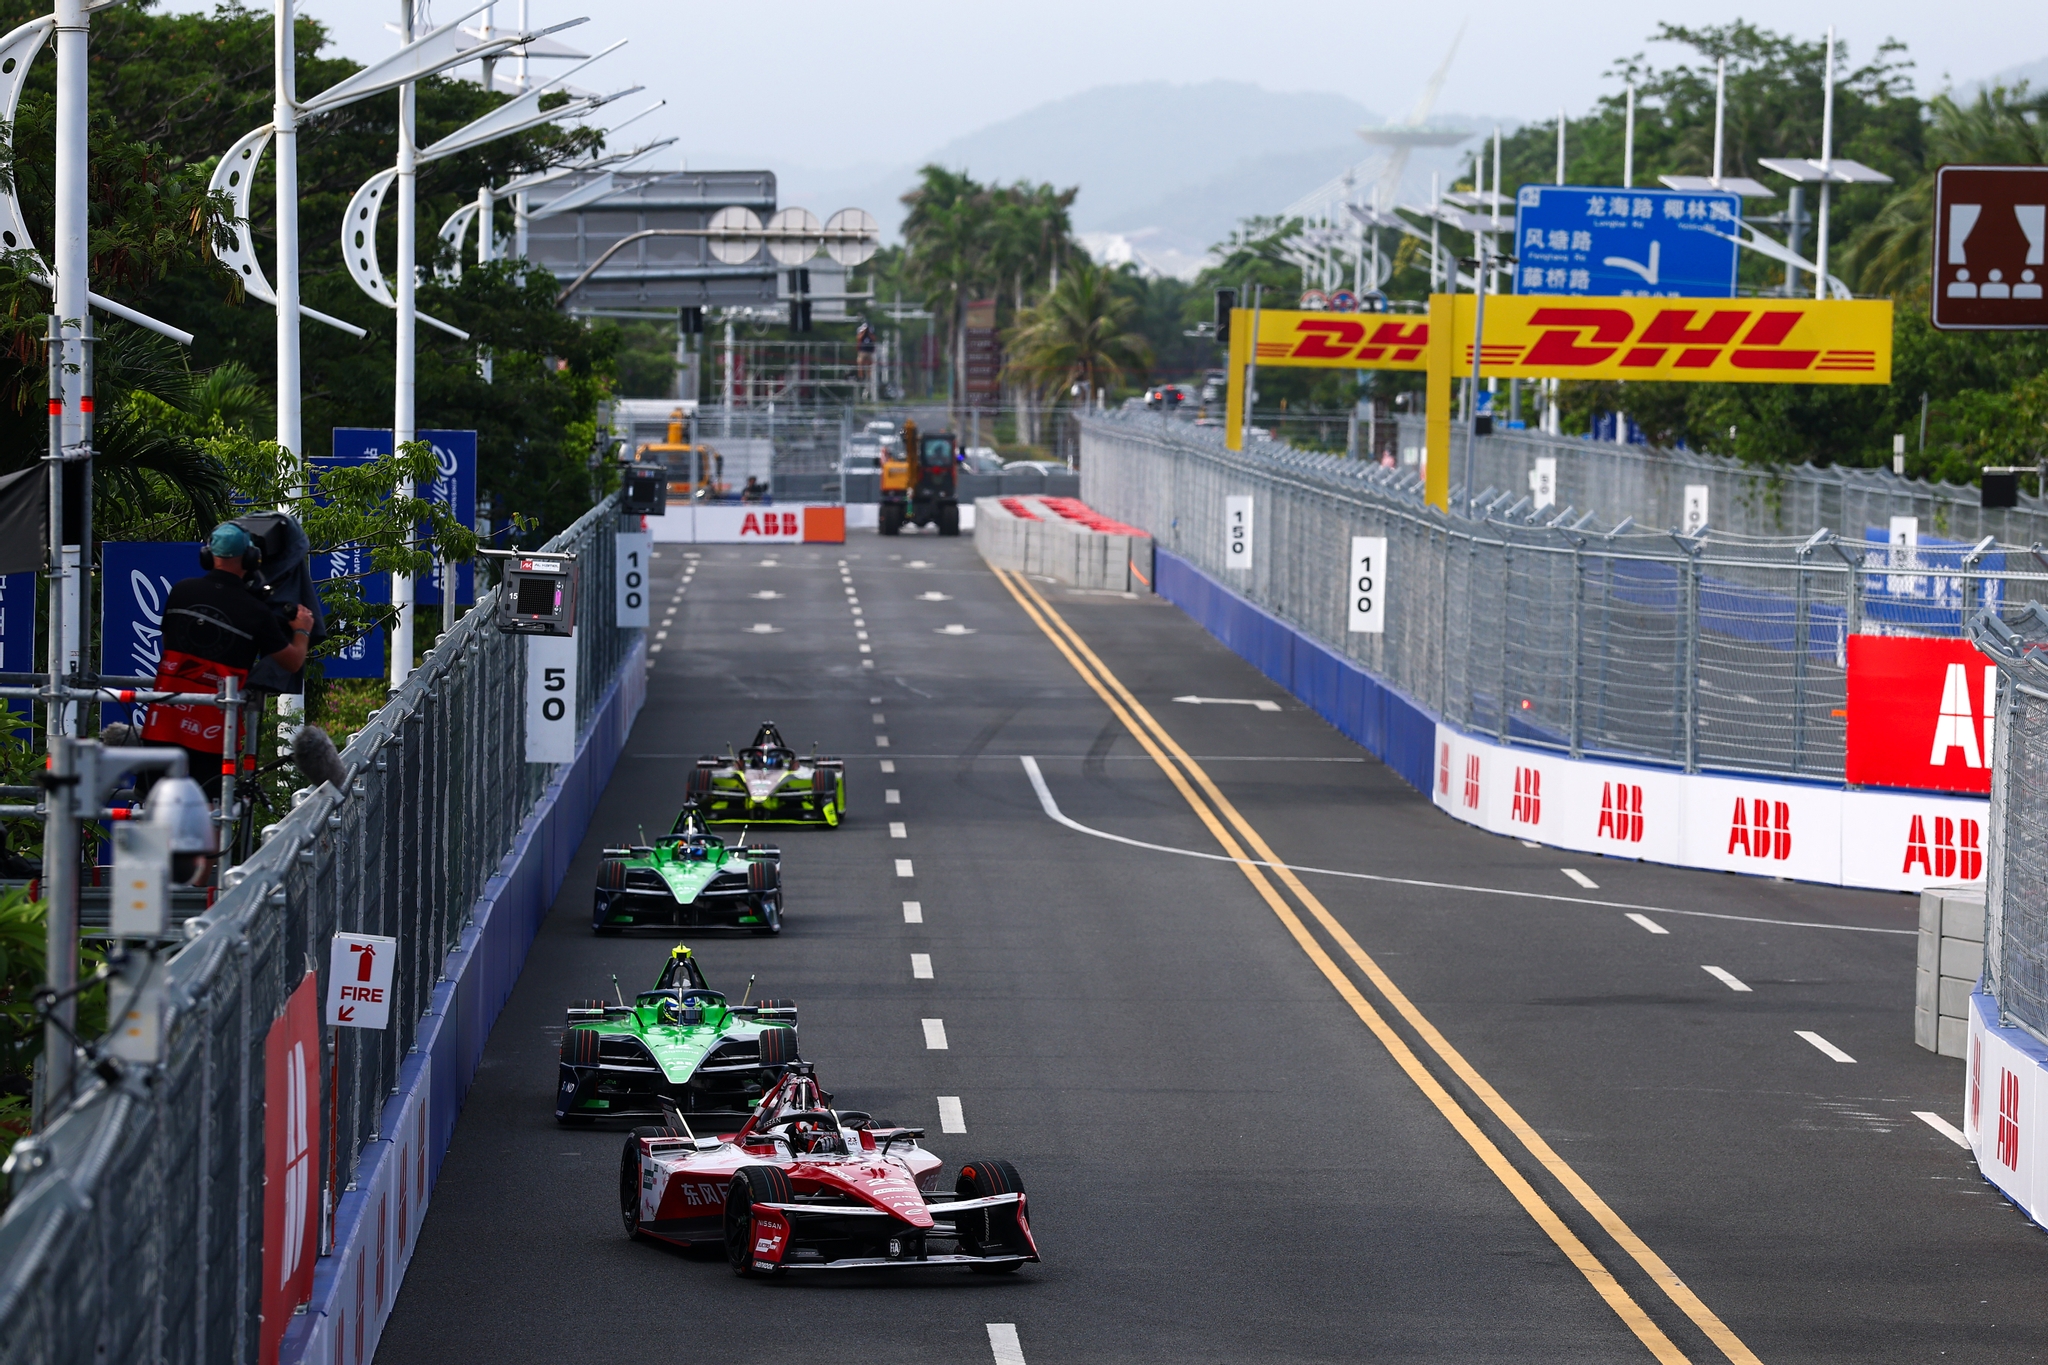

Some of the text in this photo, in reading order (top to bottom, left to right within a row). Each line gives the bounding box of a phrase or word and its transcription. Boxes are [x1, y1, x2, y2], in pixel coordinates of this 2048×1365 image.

[1586, 195, 1653, 218] 龙海路
[1524, 228, 1592, 251] 风塘路
[1291, 319, 1429, 362] DH
[1520, 307, 1820, 370] DHL
[741, 513, 798, 536] ABB
[1232, 511, 1244, 554] 150
[509, 592, 519, 600] 15
[625, 551, 642, 609] 100
[1357, 557, 1372, 613] 100
[542, 667, 566, 721] 50
[1511, 766, 1541, 825] ABB
[1597, 781, 1645, 843] ABB
[1728, 796, 1792, 860] ABB
[1902, 814, 1982, 880] ABB
[341, 985, 384, 1003] FIRE
[1997, 1066, 2019, 1172] ABB
[758, 1220, 782, 1230] NISSAN
